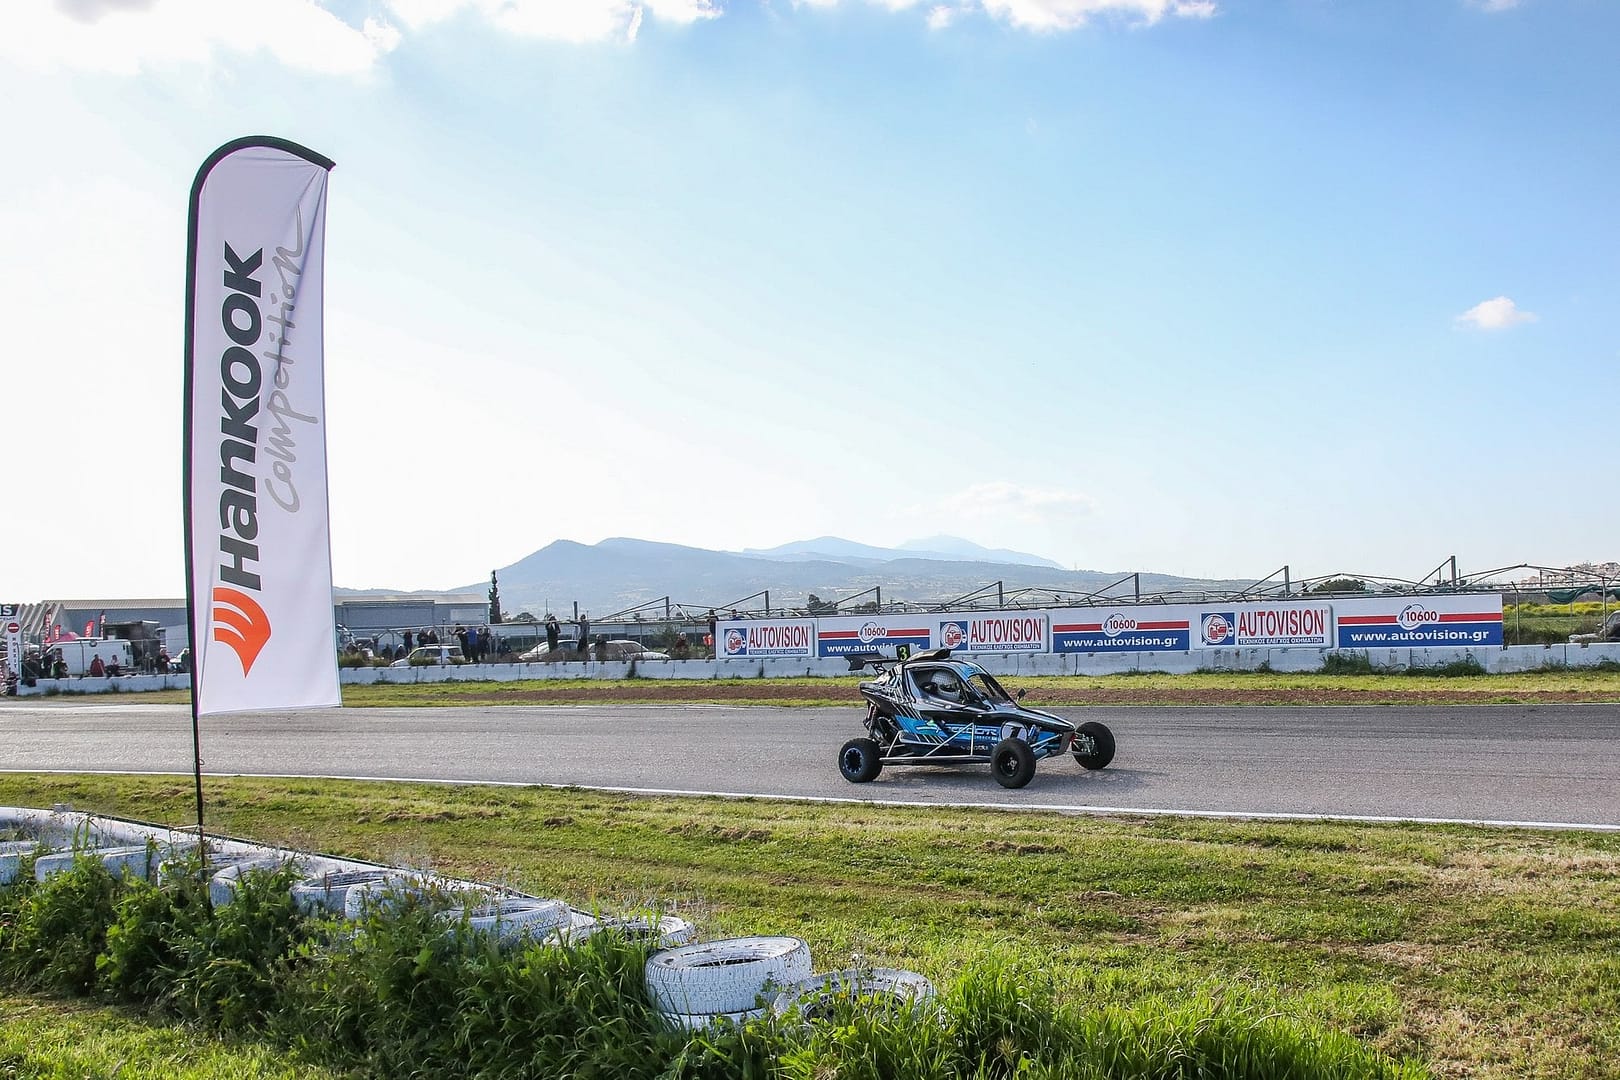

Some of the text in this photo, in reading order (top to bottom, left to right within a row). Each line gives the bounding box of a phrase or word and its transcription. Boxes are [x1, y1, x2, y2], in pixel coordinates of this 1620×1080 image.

[1238, 609, 1324, 636] AUTOVISION
[1406, 610, 1438, 622] 10600
[970, 618, 1042, 643] AUTOVISION
[1109, 619, 1136, 630] 10600
[748, 625, 809, 649] AUTOVISION
[863, 627, 887, 637] 10600
[1351, 629, 1489, 642] www.autovision.gr
[1063, 636, 1179, 648] www.autovision.gr
[899, 646, 908, 661] 3
